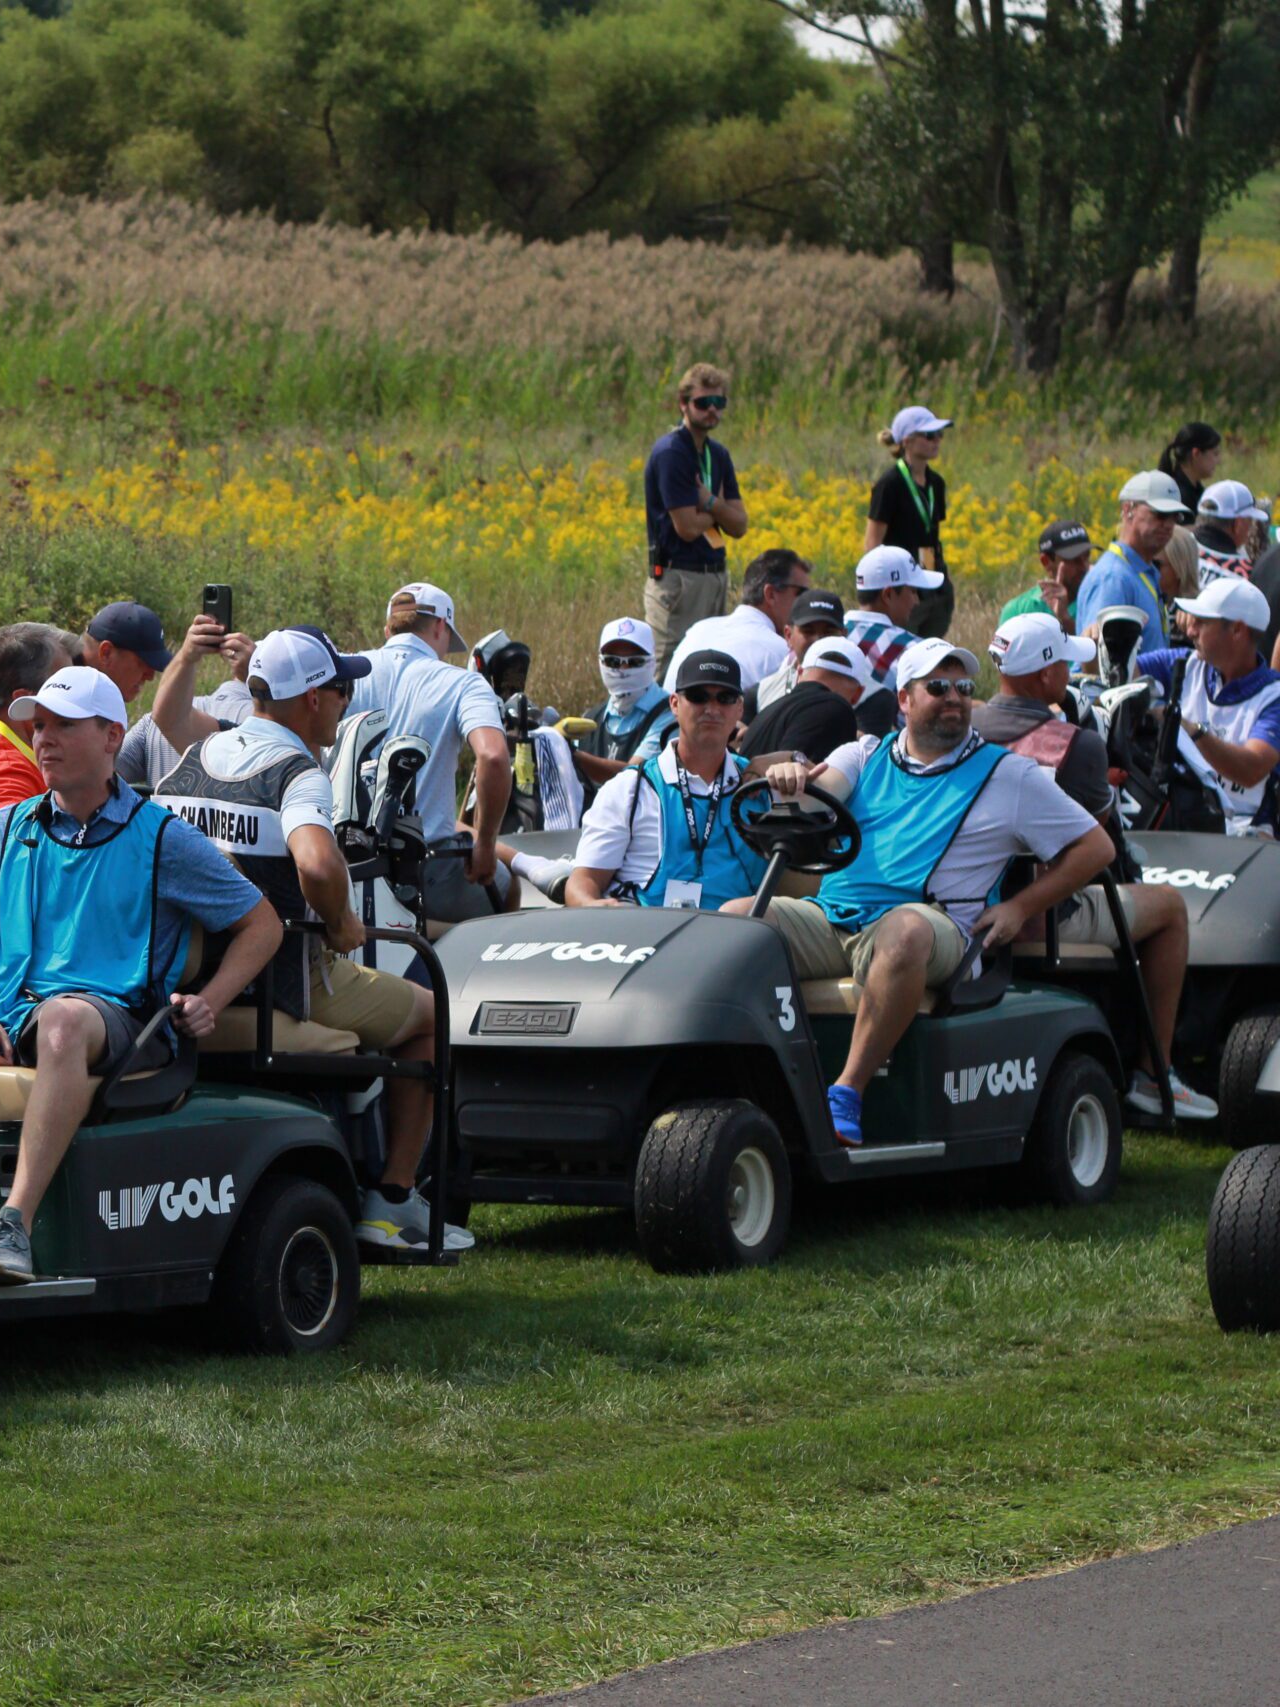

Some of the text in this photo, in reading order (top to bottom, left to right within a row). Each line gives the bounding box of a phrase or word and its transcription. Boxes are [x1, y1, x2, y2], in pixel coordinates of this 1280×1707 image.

[1042, 646, 1054, 662] FJ
[167, 805, 259, 846] CHAMBEAU
[1141, 866, 1237, 891] GOLF
[775, 986, 796, 1031] 3
